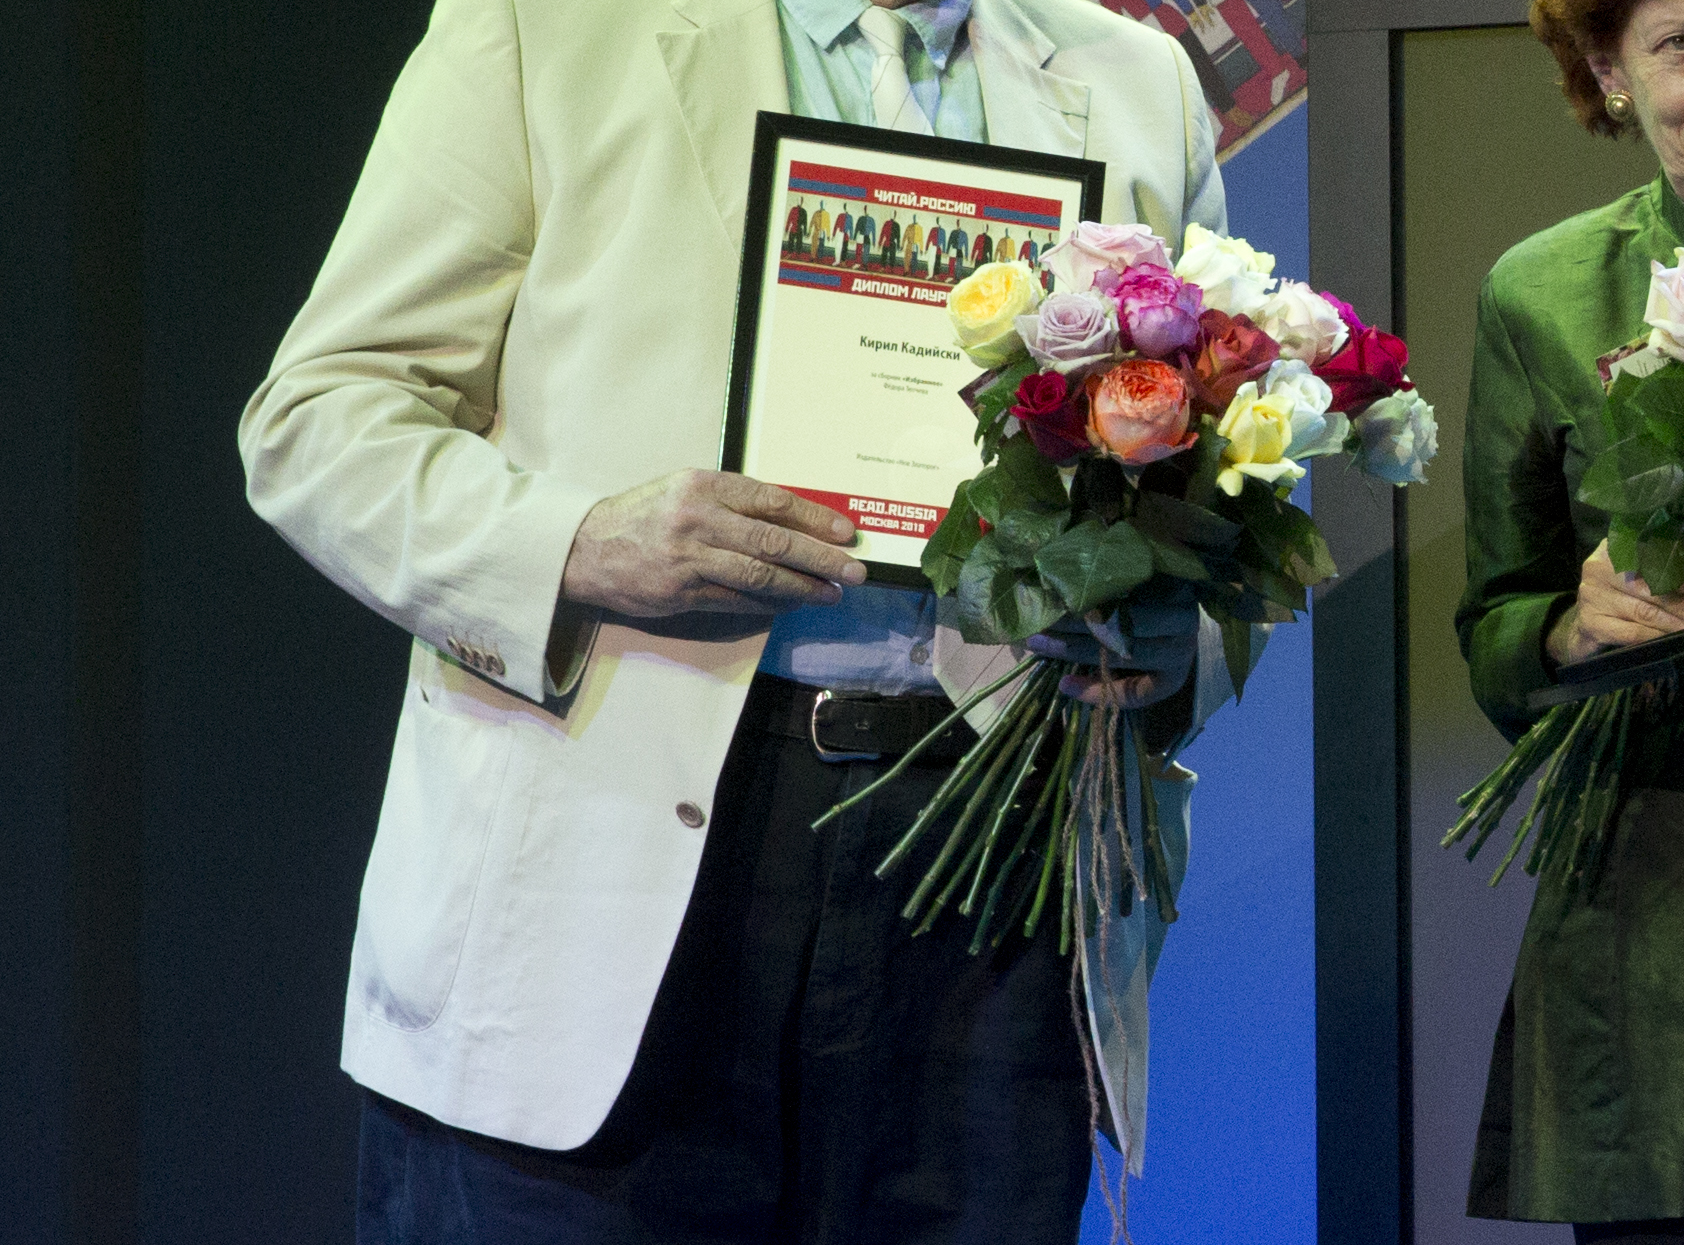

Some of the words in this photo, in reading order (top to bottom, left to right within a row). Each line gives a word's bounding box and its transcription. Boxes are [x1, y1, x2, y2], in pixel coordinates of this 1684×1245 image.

[874, 188, 977, 216] ЧИТАЙ.РОССИЮ
[852, 278, 909, 298] ДИПЛОМ
[911, 288, 950, 304] ЛАУР
[860, 335, 898, 352] Кирил
[901, 341, 961, 361] Кадийски
[860, 515, 900, 529] МОСКВА
[901, 520, 926, 534] 2018
